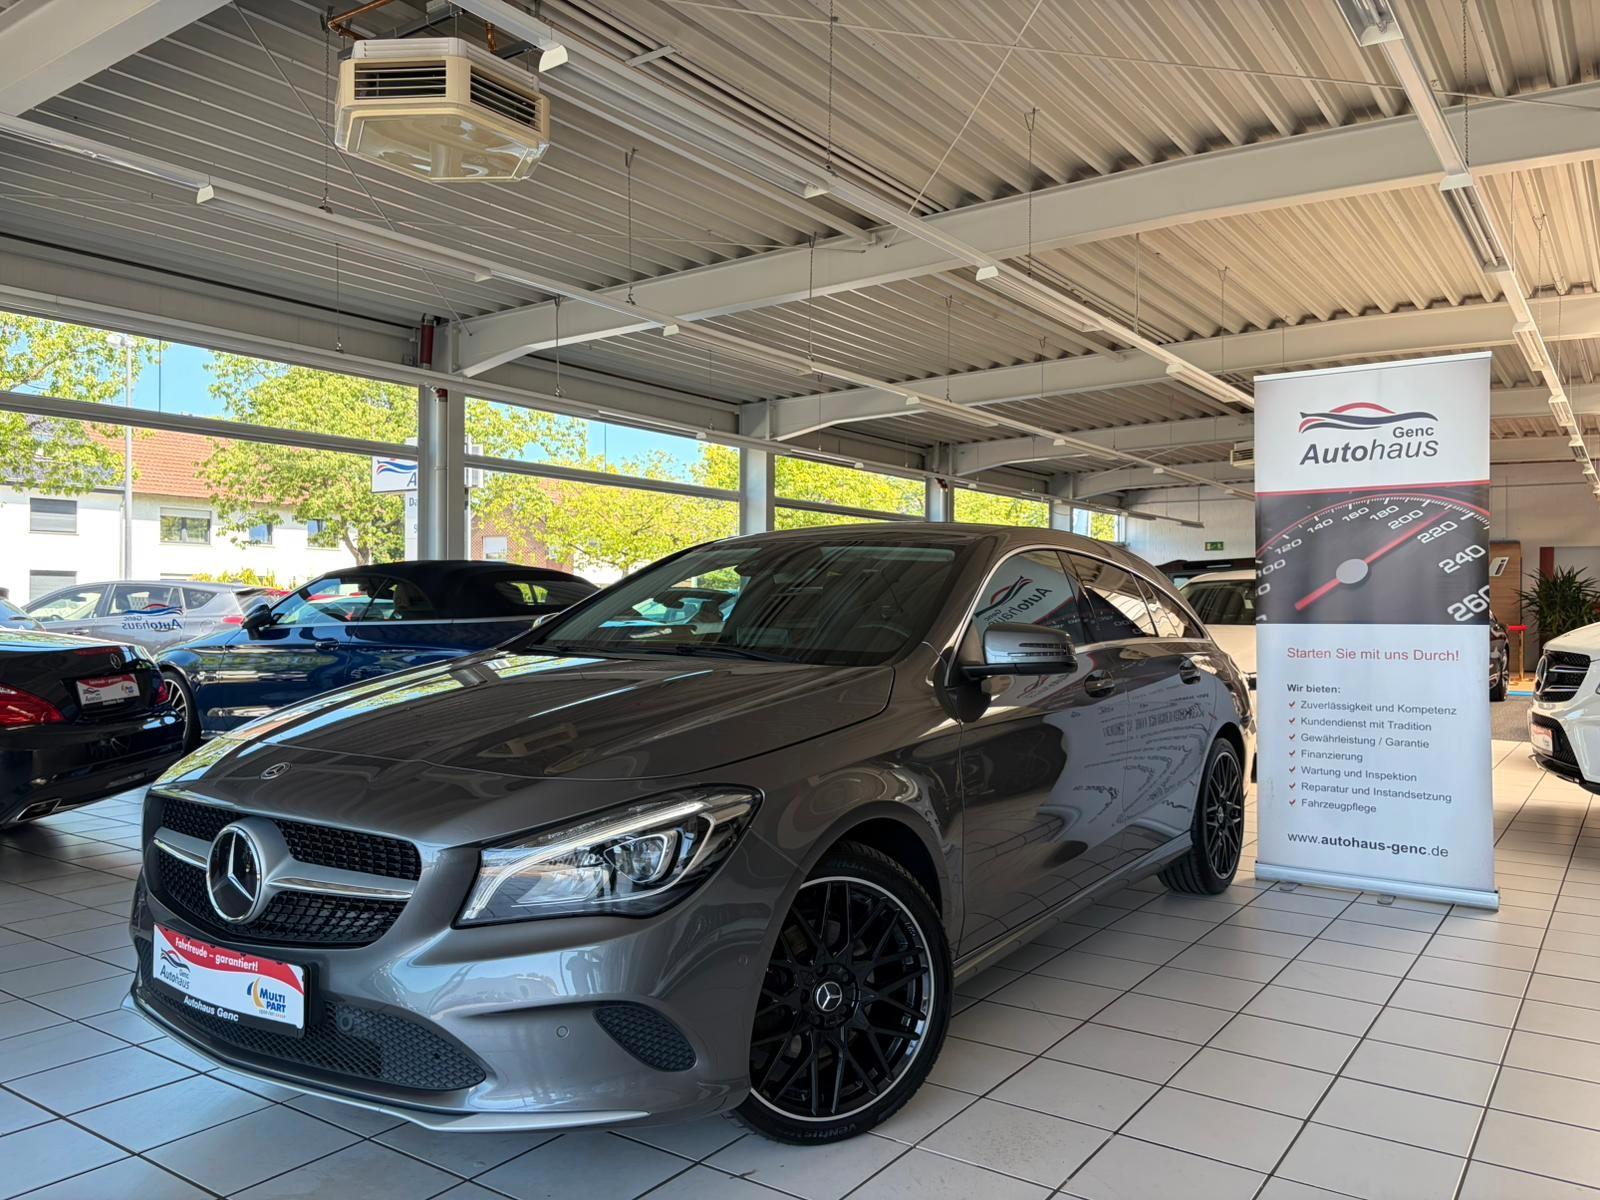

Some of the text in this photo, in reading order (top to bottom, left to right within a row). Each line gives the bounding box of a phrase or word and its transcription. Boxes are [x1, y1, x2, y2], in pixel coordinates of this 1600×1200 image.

[1393, 427, 1434, 438] Genc
[1300, 439, 1439, 465] Autohaus
[1342, 507, 1370, 521] 160
[1369, 505, 1399, 520] 180
[1388, 510, 1423, 529] 200
[1307, 518, 1333, 533] 140
[1417, 521, 1458, 544] 220
[1274, 539, 1302, 554] 120
[1438, 545, 1486, 574] 240
[1255, 583, 1271, 596] 0
[1287, 647, 1460, 662] Starten Sie mit uns Durch!
[1287, 683, 1341, 694] Wir bieten:
[1300, 700, 1457, 716] Zuverlässigkeit und Kompetenz
[1300, 717, 1432, 732] Kundendienst mit Tradition
[1300, 733, 1376, 747] Gewährleistung
[1385, 737, 1430, 749] Garantie
[1300, 749, 1364, 763] Finanzierung
[1300, 765, 1417, 783] Wartung und Inspektion
[1301, 782, 1452, 804] Reparatur und Instandsetzung
[1301, 798, 1377, 814] Fahrzeugpflege
[1287, 833, 1449, 858] www.autohaus-genc.de
[175, 936, 208, 958] Fahrfreude
[215, 954, 259, 972] garantiert!
[160, 964, 190, 989] Autohaus
[259, 987, 286, 1004] MULTI
[183, 995, 215, 1015] Autohaus
[216, 1007, 239, 1021] Genc
[266, 1001, 287, 1013] PART
